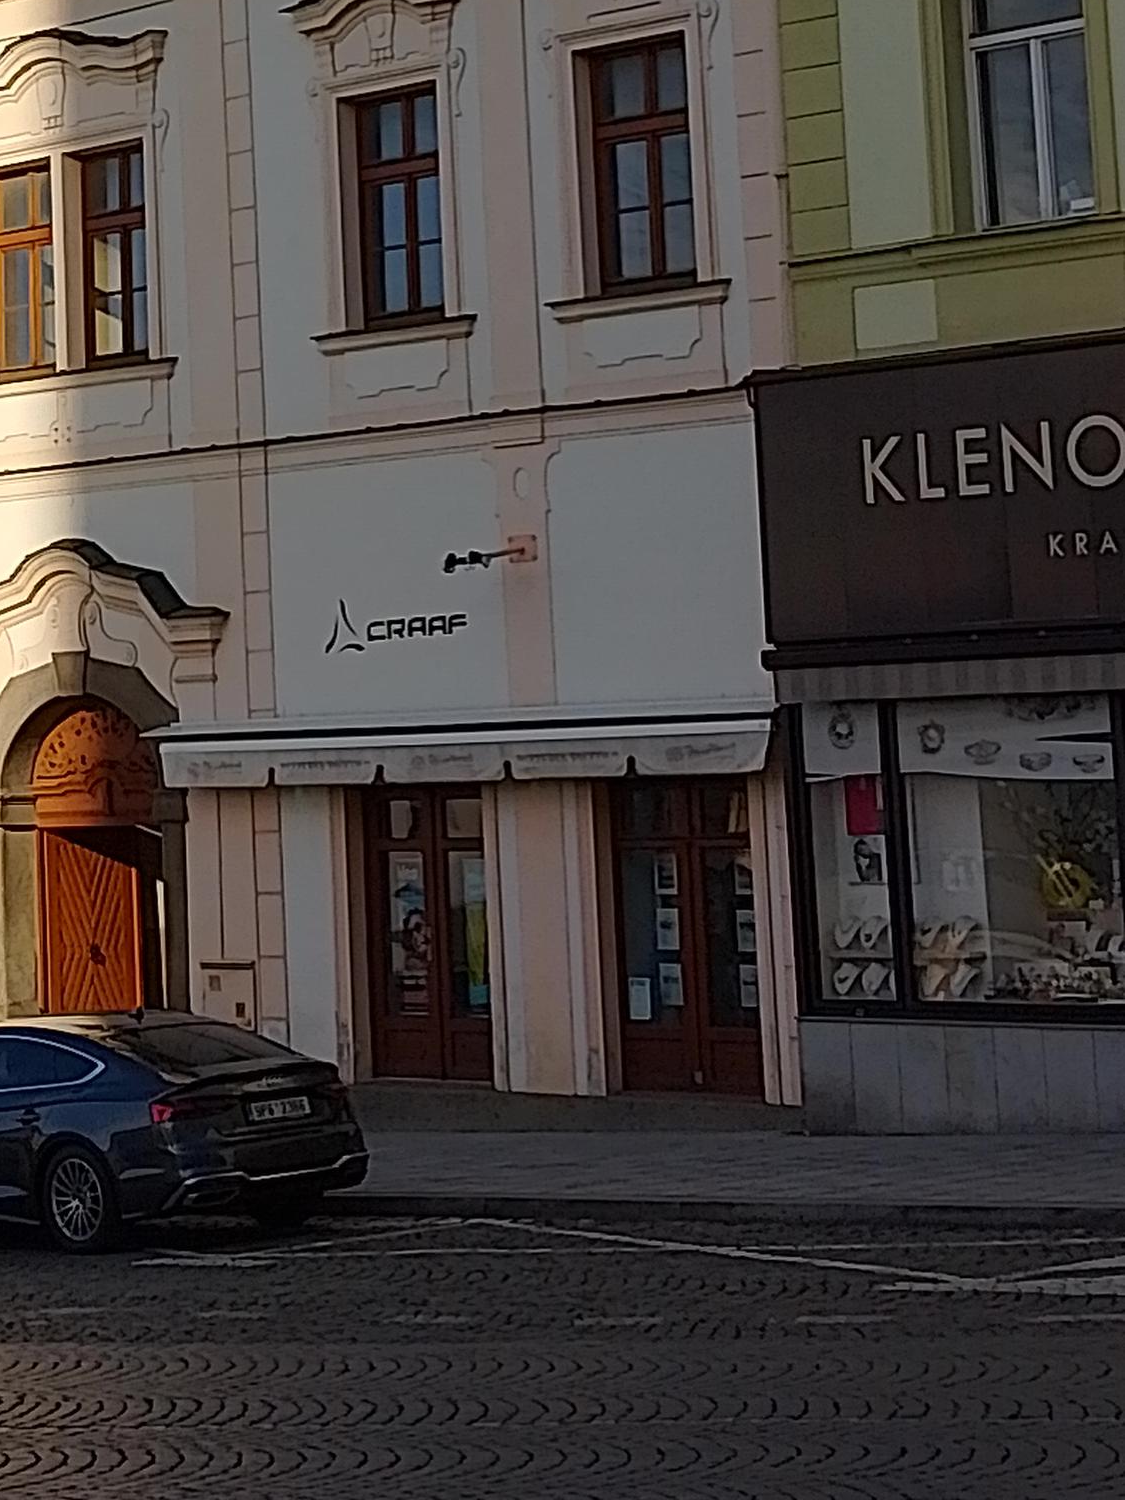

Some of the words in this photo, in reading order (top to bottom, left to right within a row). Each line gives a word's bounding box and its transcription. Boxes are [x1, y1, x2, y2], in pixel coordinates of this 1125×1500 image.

[861, 414, 1125, 505] KLENO
[1047, 531, 1119, 557] KRA
[367, 613, 468, 642] CRAAF
